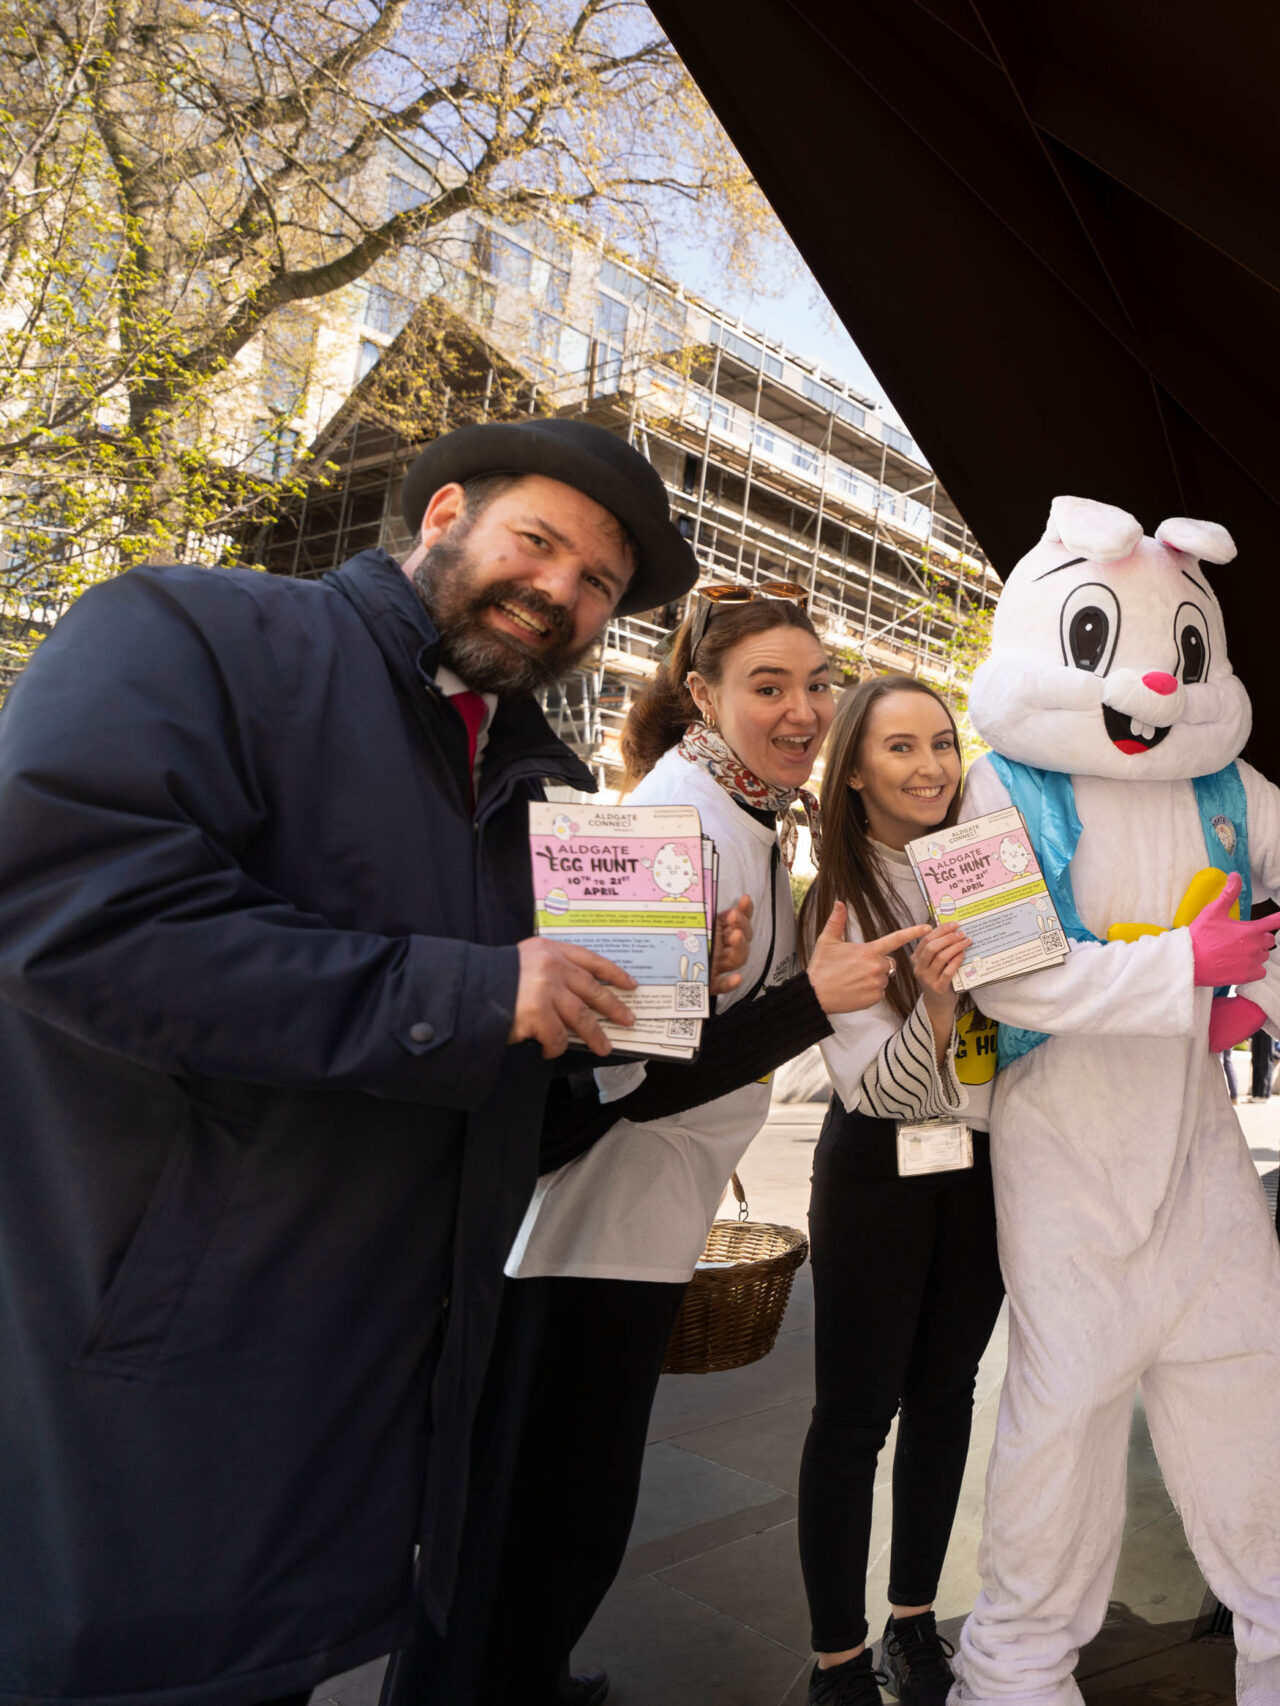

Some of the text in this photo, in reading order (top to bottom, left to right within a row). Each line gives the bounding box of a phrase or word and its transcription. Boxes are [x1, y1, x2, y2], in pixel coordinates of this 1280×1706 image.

[595, 813, 638, 821] ALDGATE
[588, 819, 631, 828] CONNECT
[558, 845, 630, 855] ALDGATE
[544, 852, 638, 873] EGG HUNT
[937, 848, 982, 869] ALDGATE
[929, 855, 991, 884] EGG HUNT
[584, 887, 619, 896] APRIL
[961, 882, 984, 894] APRIL
